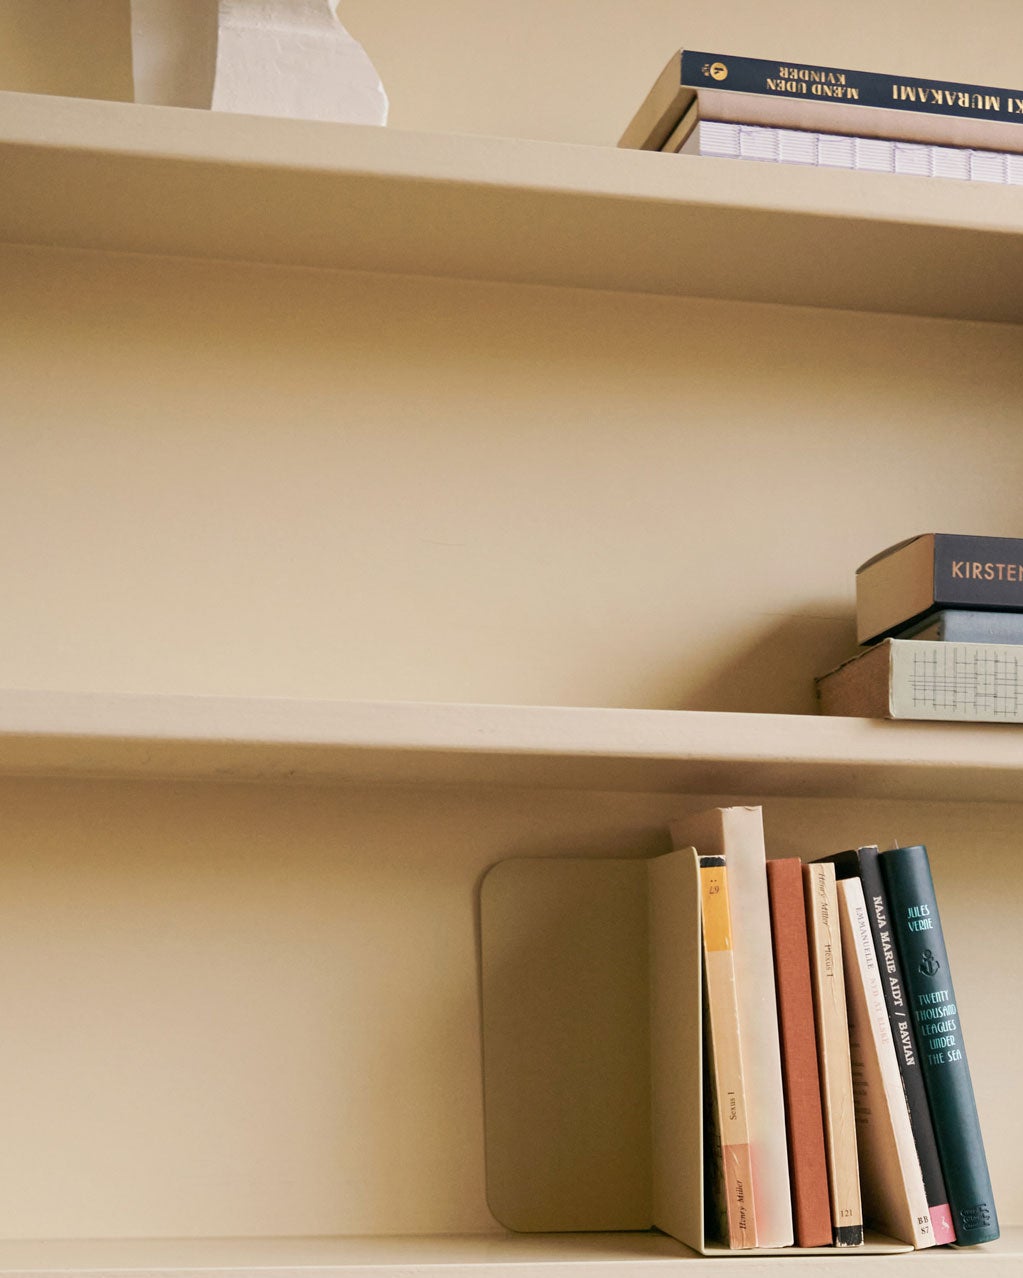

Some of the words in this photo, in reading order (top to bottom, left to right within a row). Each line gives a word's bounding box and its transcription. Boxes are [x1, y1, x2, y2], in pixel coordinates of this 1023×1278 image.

[778, 66, 846, 86] KVINDER
[765, 77, 808, 97] UDEN
[811, 81, 859, 100] MÆND
[891, 84, 1001, 111] MURAKAMI
[907, 904, 930, 919] JULES
[907, 918, 934, 933] VERNE
[855, 907, 874, 970] EMMANUELLE
[872, 896, 887, 929] NAJA
[880, 931, 897, 974] MARIE
[889, 977, 904, 1007] AIDT
[898, 1021, 916, 1067] BAVIAN
[918, 989, 949, 1006] TWENTY
[914, 1003, 957, 1022] THOUSAND
[922, 1019, 957, 1036] LEAGUES
[929, 1034, 956, 1051] UNDER
[927, 1053, 945, 1067] THE
[947, 1052, 963, 1064] SEA
[728, 1099, 737, 1121] Sexus
[734, 1179, 745, 1203] Miller
[738, 1203, 749, 1231] Henry
